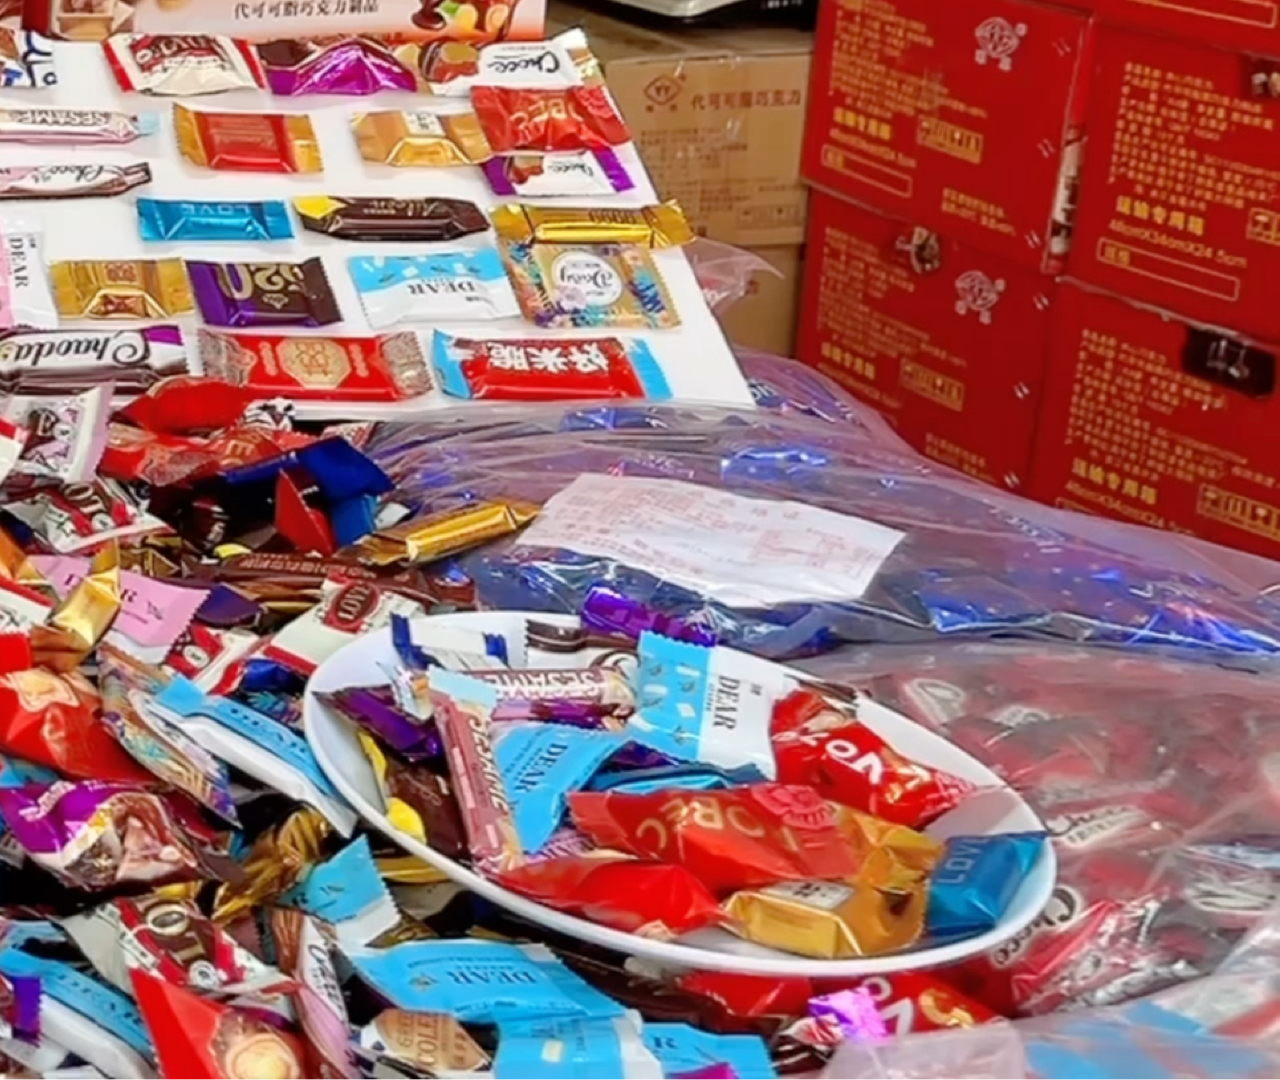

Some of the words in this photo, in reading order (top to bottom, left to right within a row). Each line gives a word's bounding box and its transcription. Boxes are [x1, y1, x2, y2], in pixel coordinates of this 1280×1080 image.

[9, 109, 109, 128] SESAME
[9, 236, 31, 289] DEAR
[407, 278, 475, 297] DEAR
[12, 334, 144, 367] Chaoda
[488, 342, 609, 373] 好米脆
[497, 668, 600, 701] SESAME
[713, 676, 740, 730] DEAR
[471, 716, 508, 811] SESAME
[514, 741, 568, 794] DEAR
[447, 968, 534, 988] DEAR
